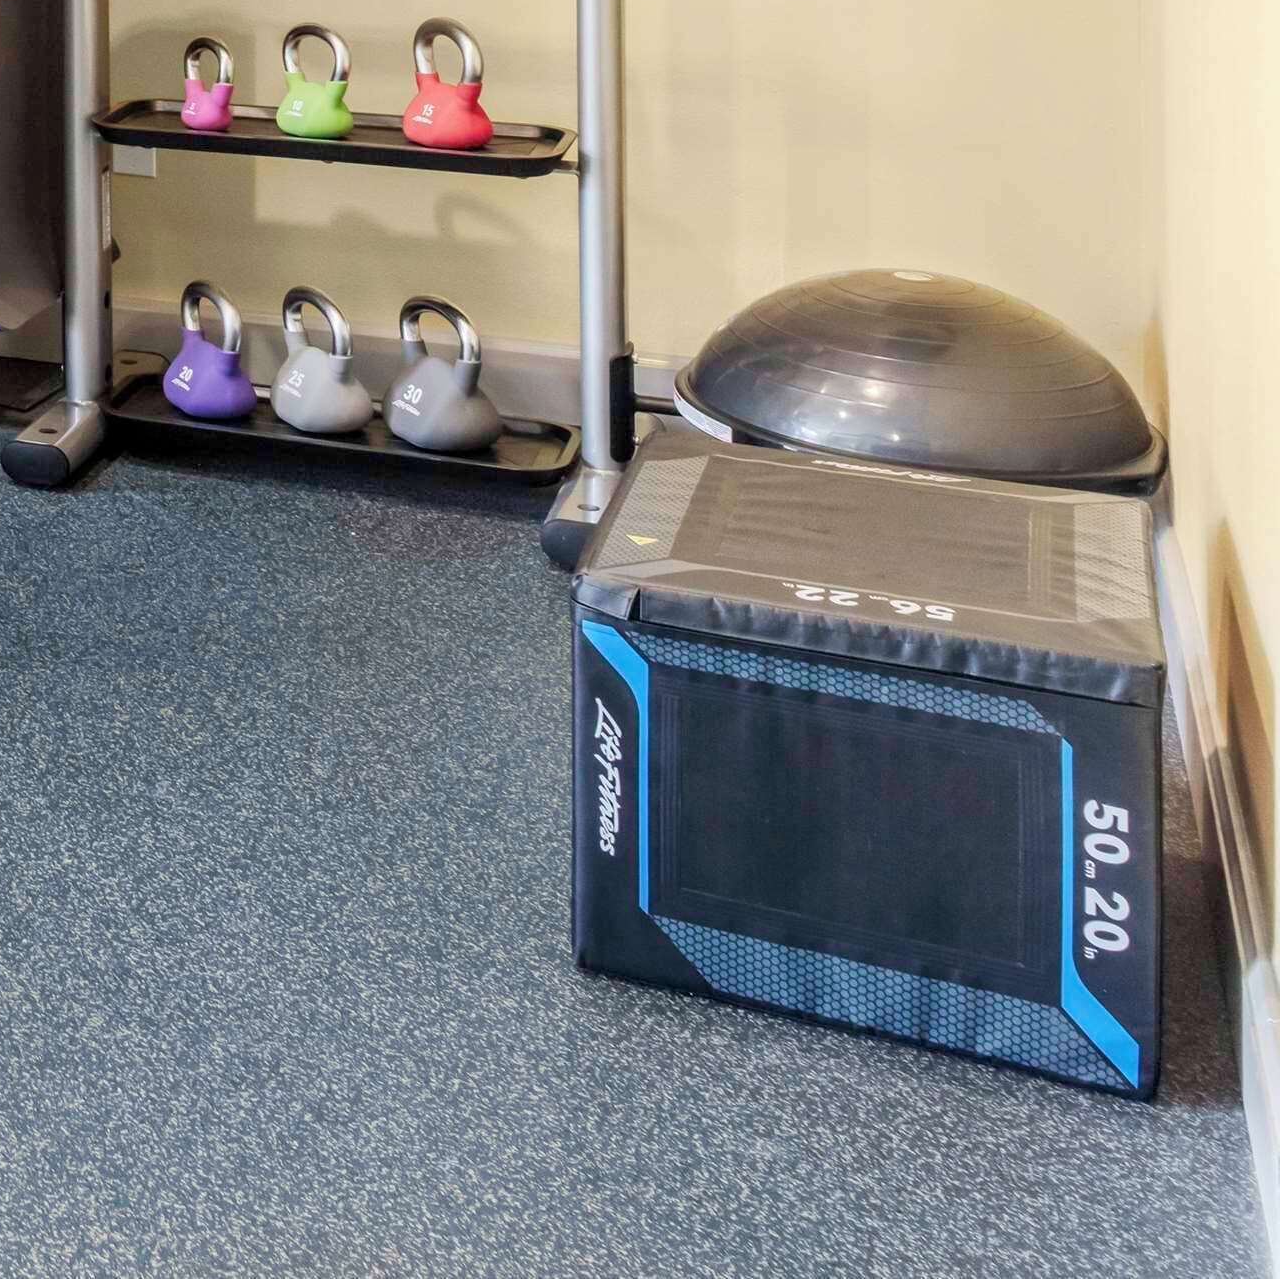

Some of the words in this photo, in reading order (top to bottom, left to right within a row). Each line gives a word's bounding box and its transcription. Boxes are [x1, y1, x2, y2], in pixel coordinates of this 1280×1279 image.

[422, 104, 435, 116] 15
[179, 366, 193, 382] 20
[289, 370, 305, 387] 25
[403, 384, 422, 404] 30
